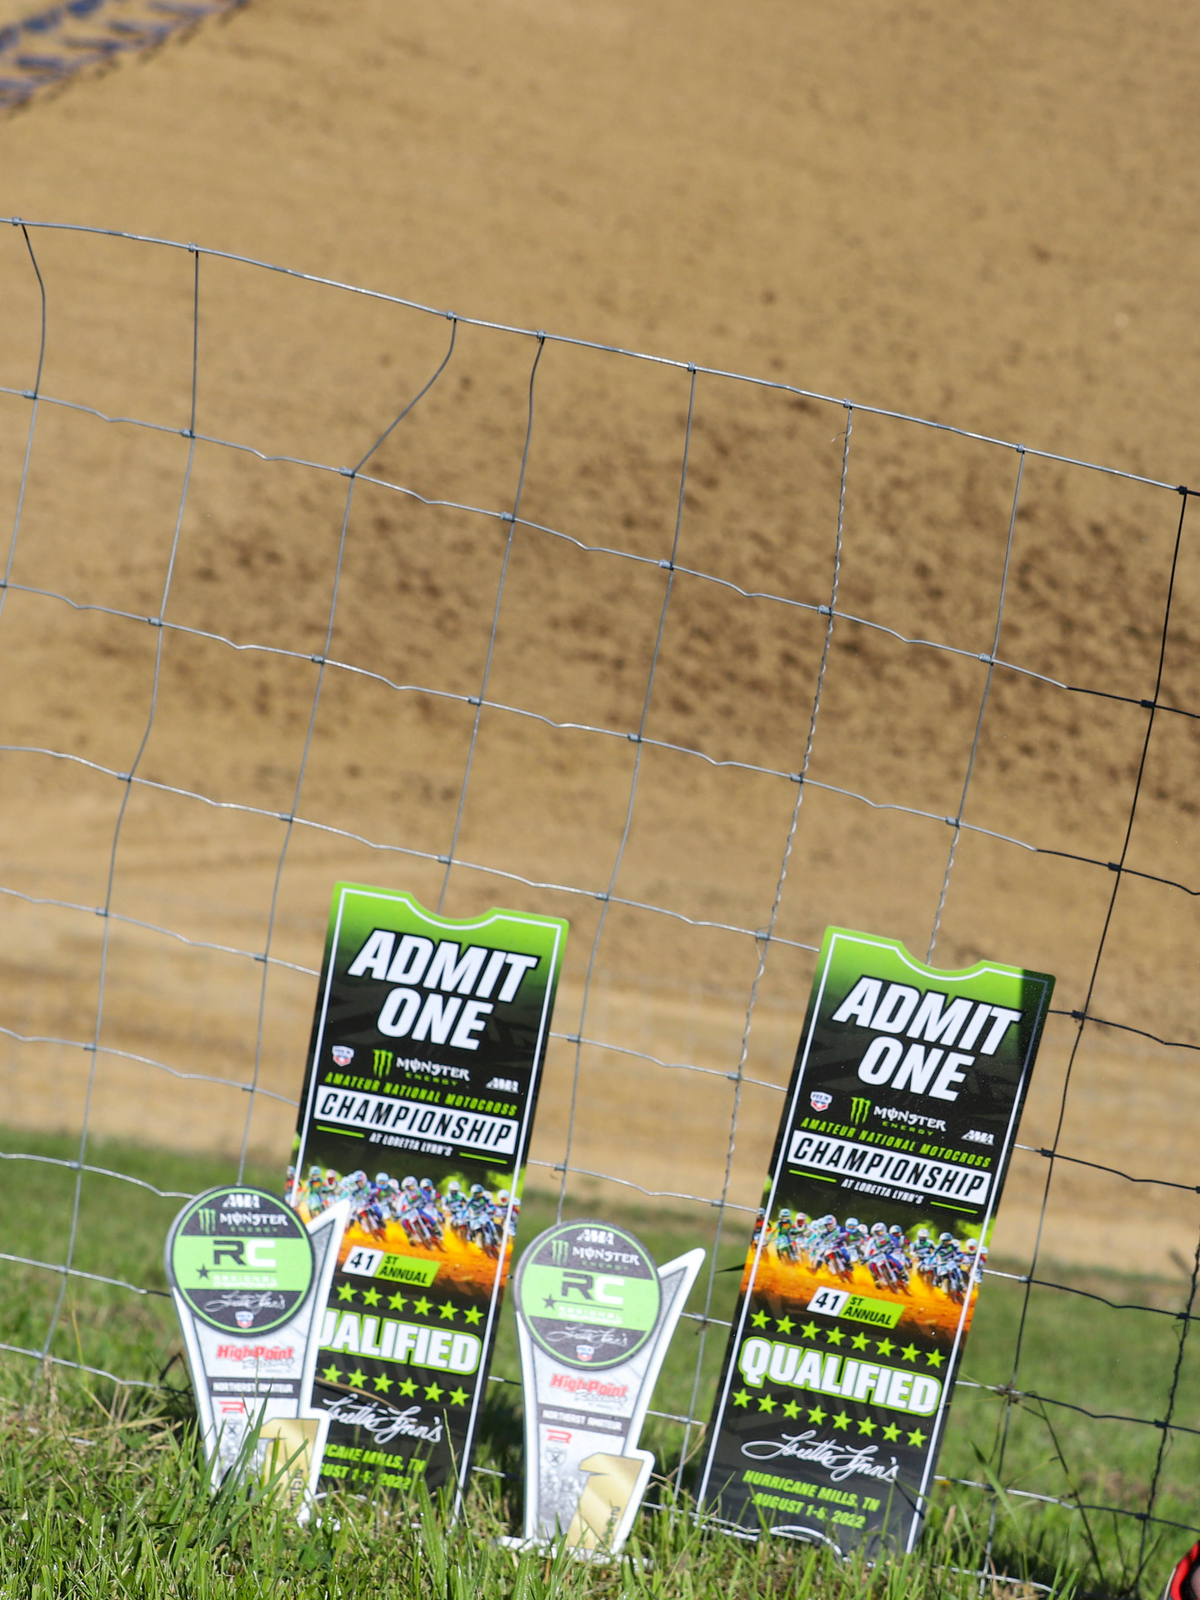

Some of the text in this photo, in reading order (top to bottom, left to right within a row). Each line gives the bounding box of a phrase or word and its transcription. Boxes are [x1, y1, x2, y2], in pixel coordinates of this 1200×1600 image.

[347, 929, 538, 1003] ADMIT
[377, 987, 494, 1050] ONE
[832, 975, 1022, 1056] ADMIT
[396, 1057, 470, 1081] MONSTER
[857, 1036, 975, 1101] ONE
[324, 1072, 517, 1116] AMATEUR NATIONAL MOTOCROSS
[321, 1093, 511, 1147] CHAMPIONSHIP
[873, 1106, 947, 1132] MONSTER
[882, 1121, 934, 1136] ENERGY
[369, 1132, 382, 1144] AT
[382, 1134, 420, 1150] LORETTA
[800, 1117, 991, 1168] AMATEUR NATIONAL MOTOCROSS
[961, 1129, 995, 1146] AMA
[794, 1137, 984, 1197] CHAMPIONSHIP
[841, 1178, 924, 1204] AT LORETTA LYNN'S
[220, 1211, 288, 1227] MONSTER
[213, 1240, 277, 1267] RC
[350, 1250, 375, 1271] 41
[385, 1256, 398, 1266] ST
[572, 1246, 640, 1265] MONSTER
[379, 1265, 429, 1284] ANNUAL
[561, 1271, 625, 1305] RC
[815, 1292, 840, 1311] 41
[849, 1297, 865, 1306] ST
[844, 1306, 893, 1325] ANNUAL
[320, 1311, 478, 1372] UALIFIED
[550, 1374, 628, 1398] High Point
[741, 1339, 941, 1413] QUALIFIED
[742, 1469, 818, 1498] HURRICANE
[862, 1496, 881, 1512] TN
[752, 1492, 805, 1514] AUGUST
[831, 1510, 866, 1529] 2022
